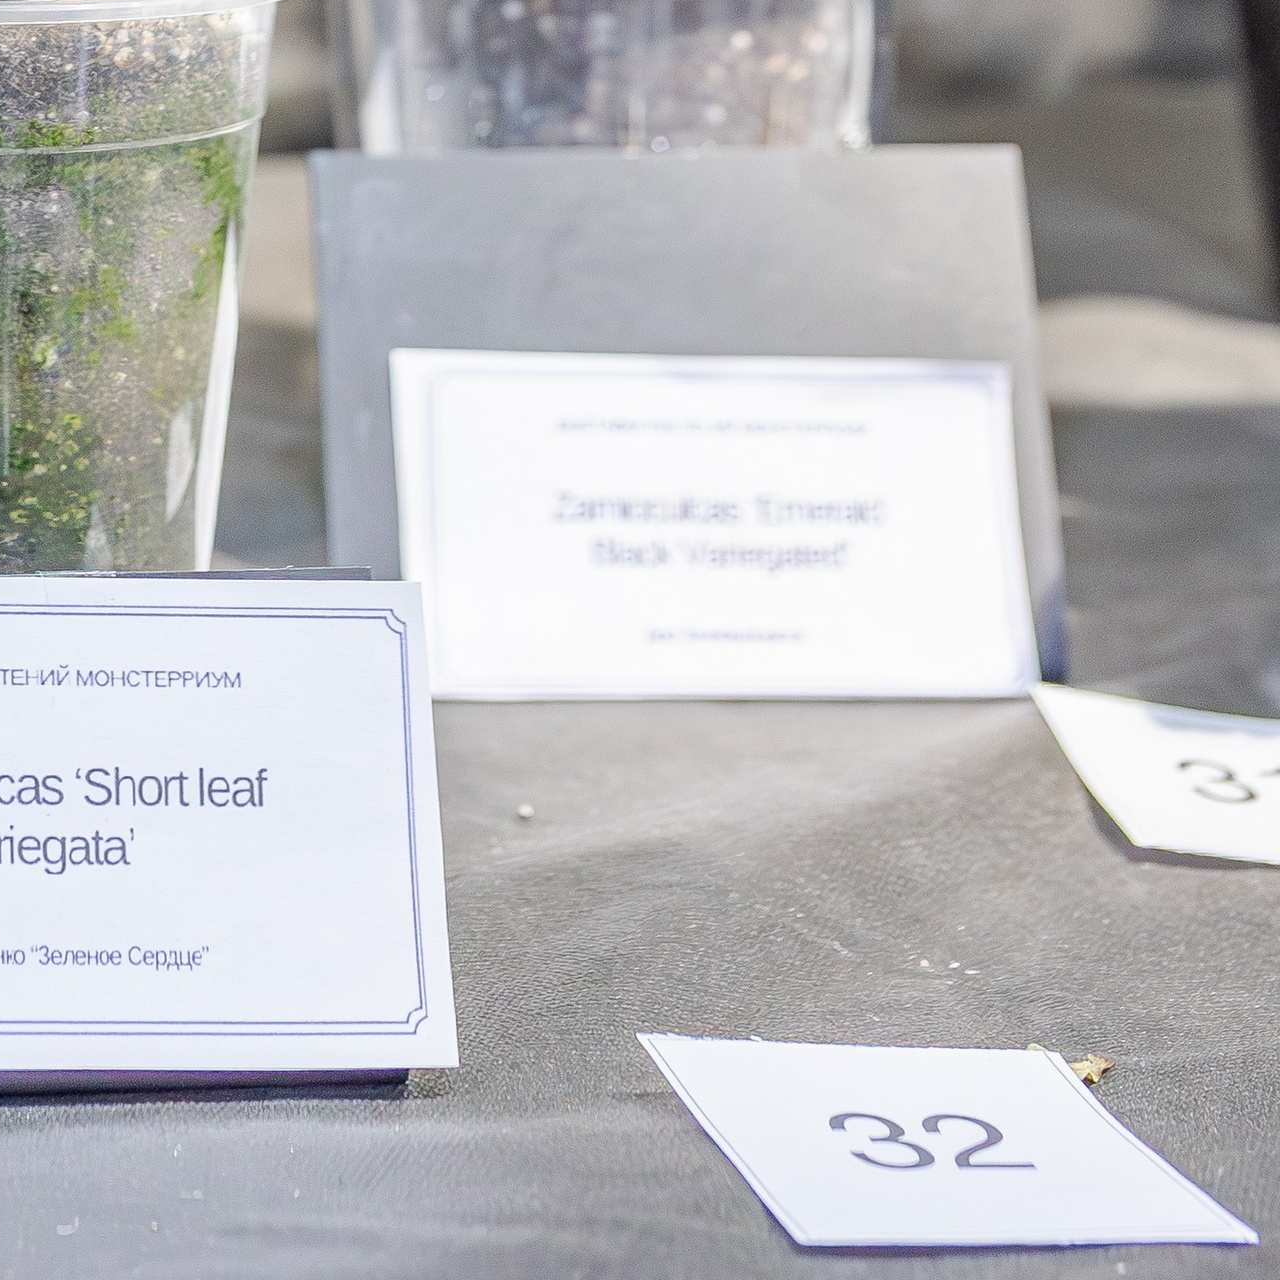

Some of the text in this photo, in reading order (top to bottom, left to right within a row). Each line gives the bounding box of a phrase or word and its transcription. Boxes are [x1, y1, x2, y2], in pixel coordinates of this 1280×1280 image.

[75, 668, 242, 689] МОНСТЕРРИУМ
[197, 766, 269, 808] leaf
[1176, 757, 1280, 805] 3
[828, 1111, 1037, 1169] 32
